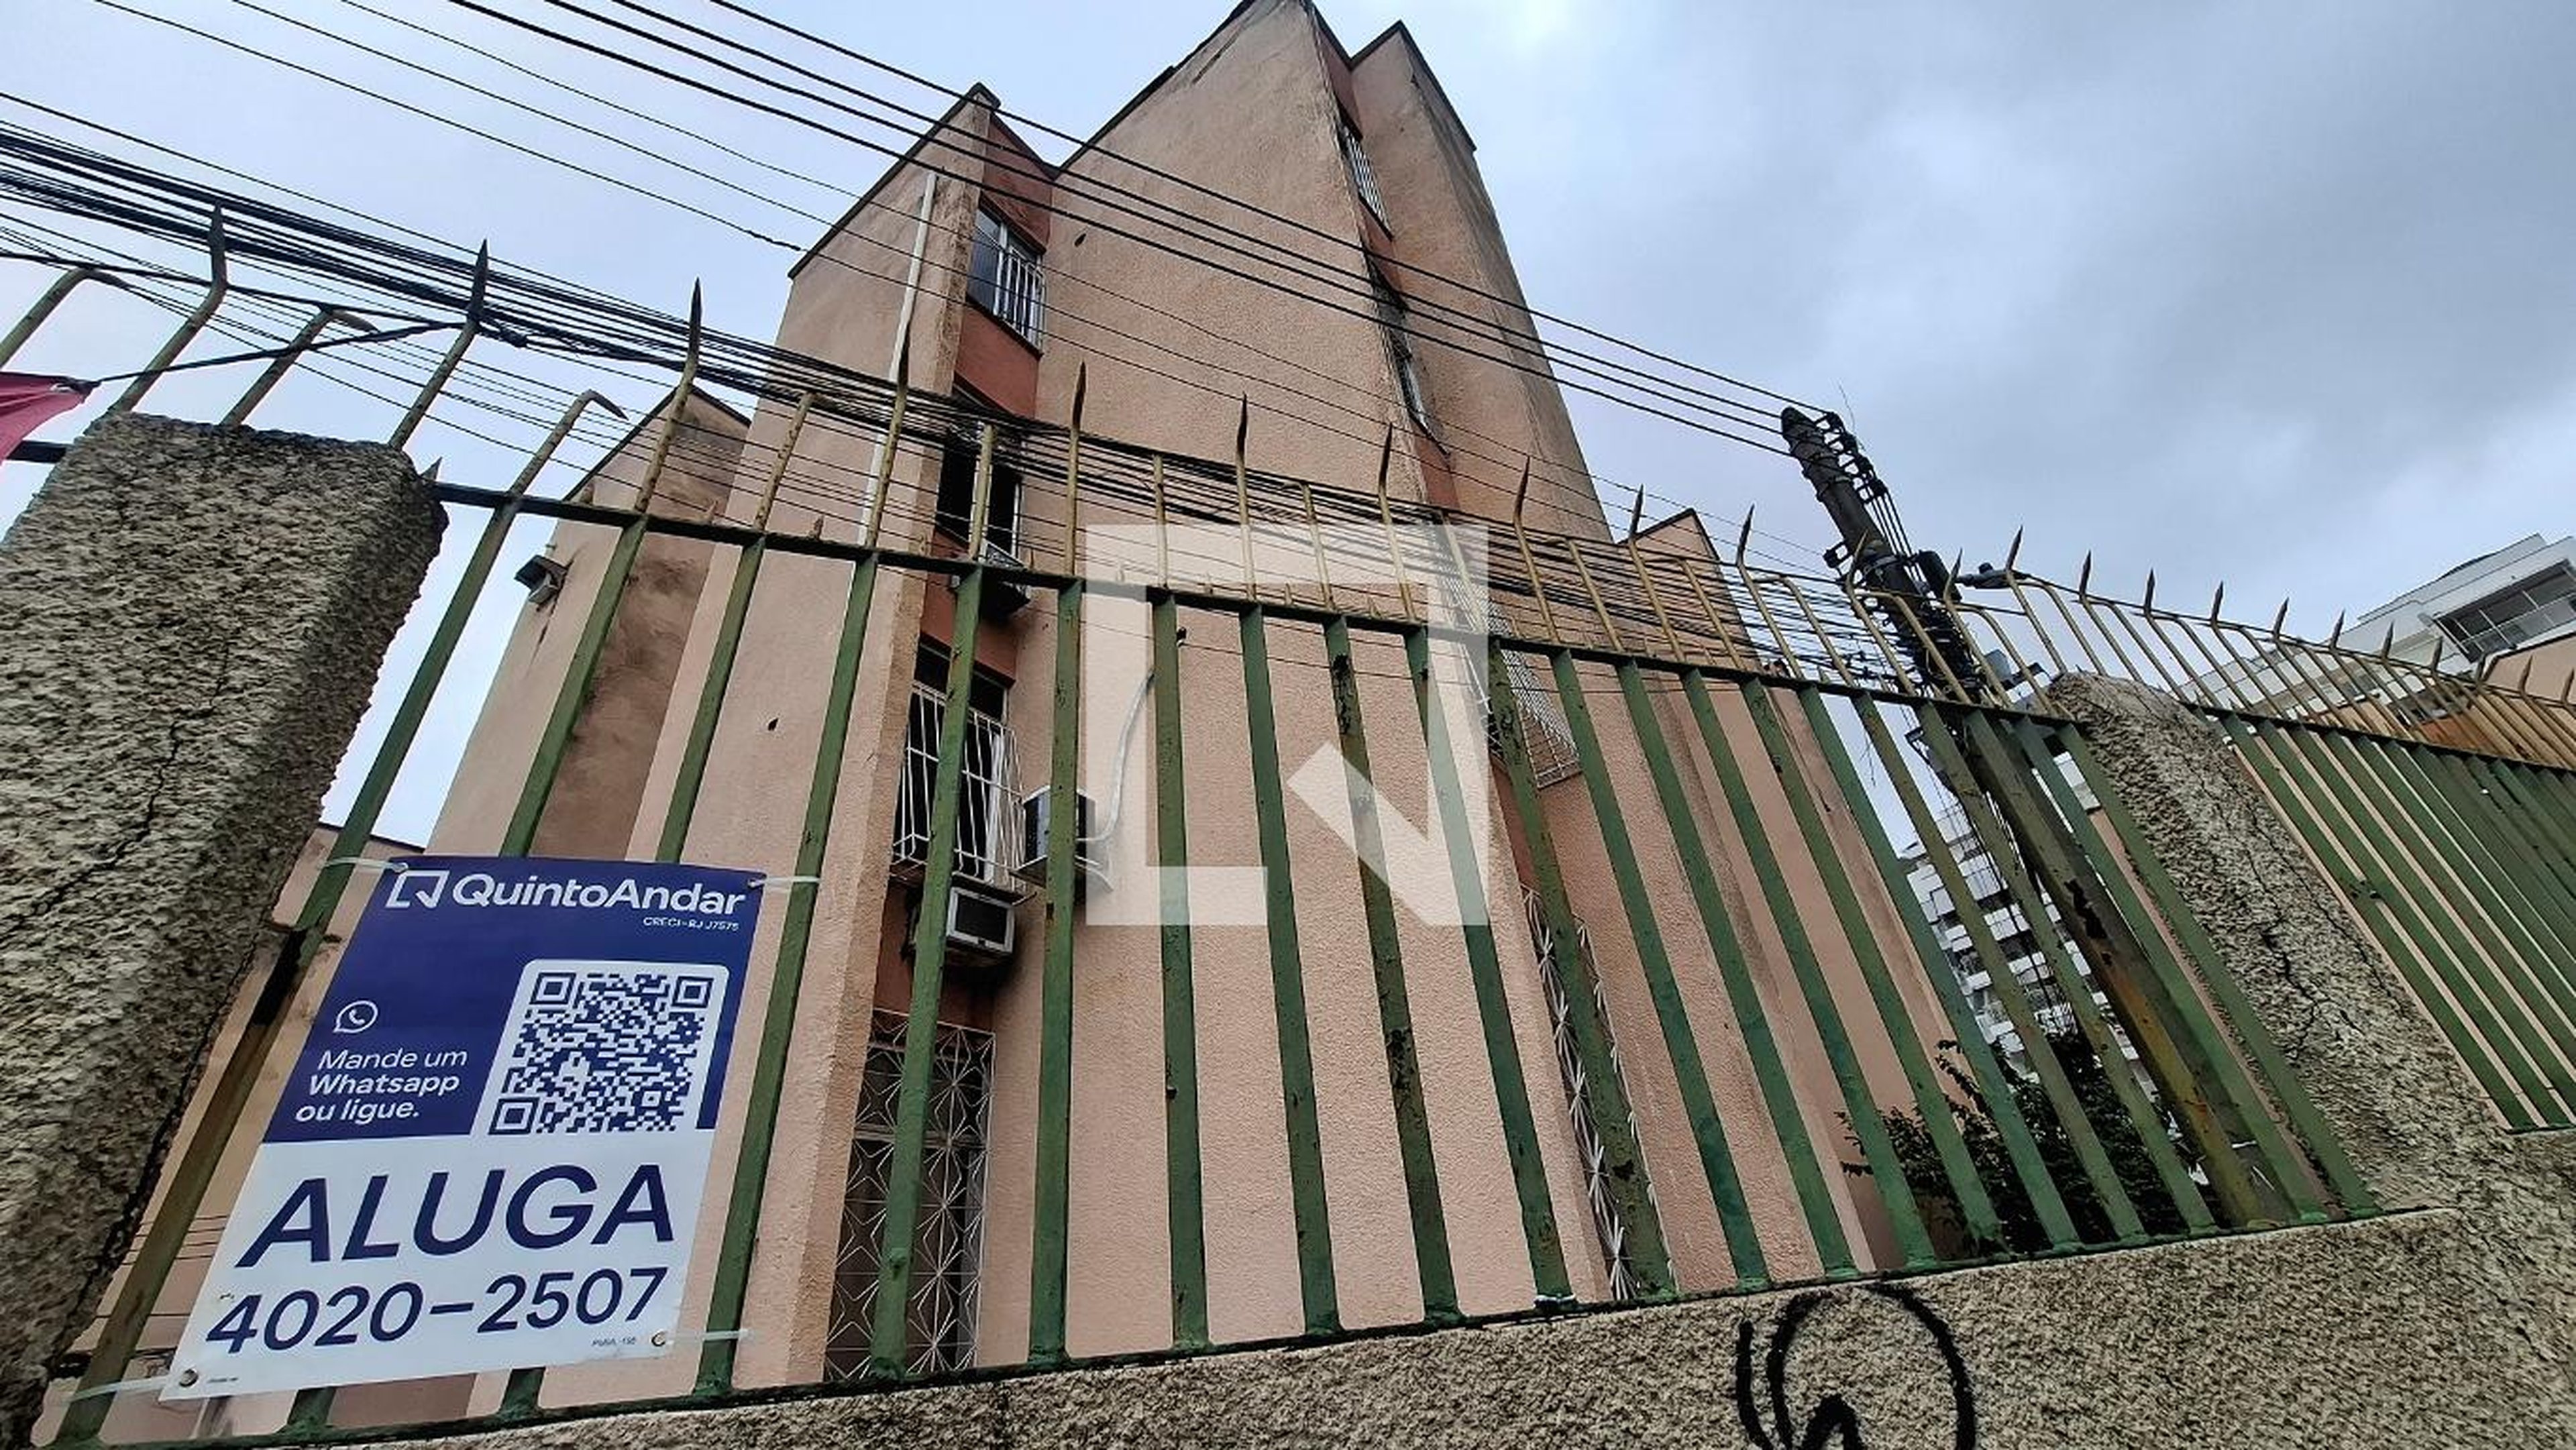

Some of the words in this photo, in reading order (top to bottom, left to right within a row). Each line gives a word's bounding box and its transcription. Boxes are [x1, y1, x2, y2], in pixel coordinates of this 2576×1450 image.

[452, 873, 745, 915] QuintoAndar
[317, 1048, 418, 1070] Mande
[424, 1050, 468, 1068] um
[309, 1074, 460, 1097] Whatsapp
[294, 1103, 336, 1123] ou
[339, 1098, 420, 1125] ligue.
[235, 1164, 674, 1268] ALUGA
[205, 1266, 668, 1354] 4020-2507
